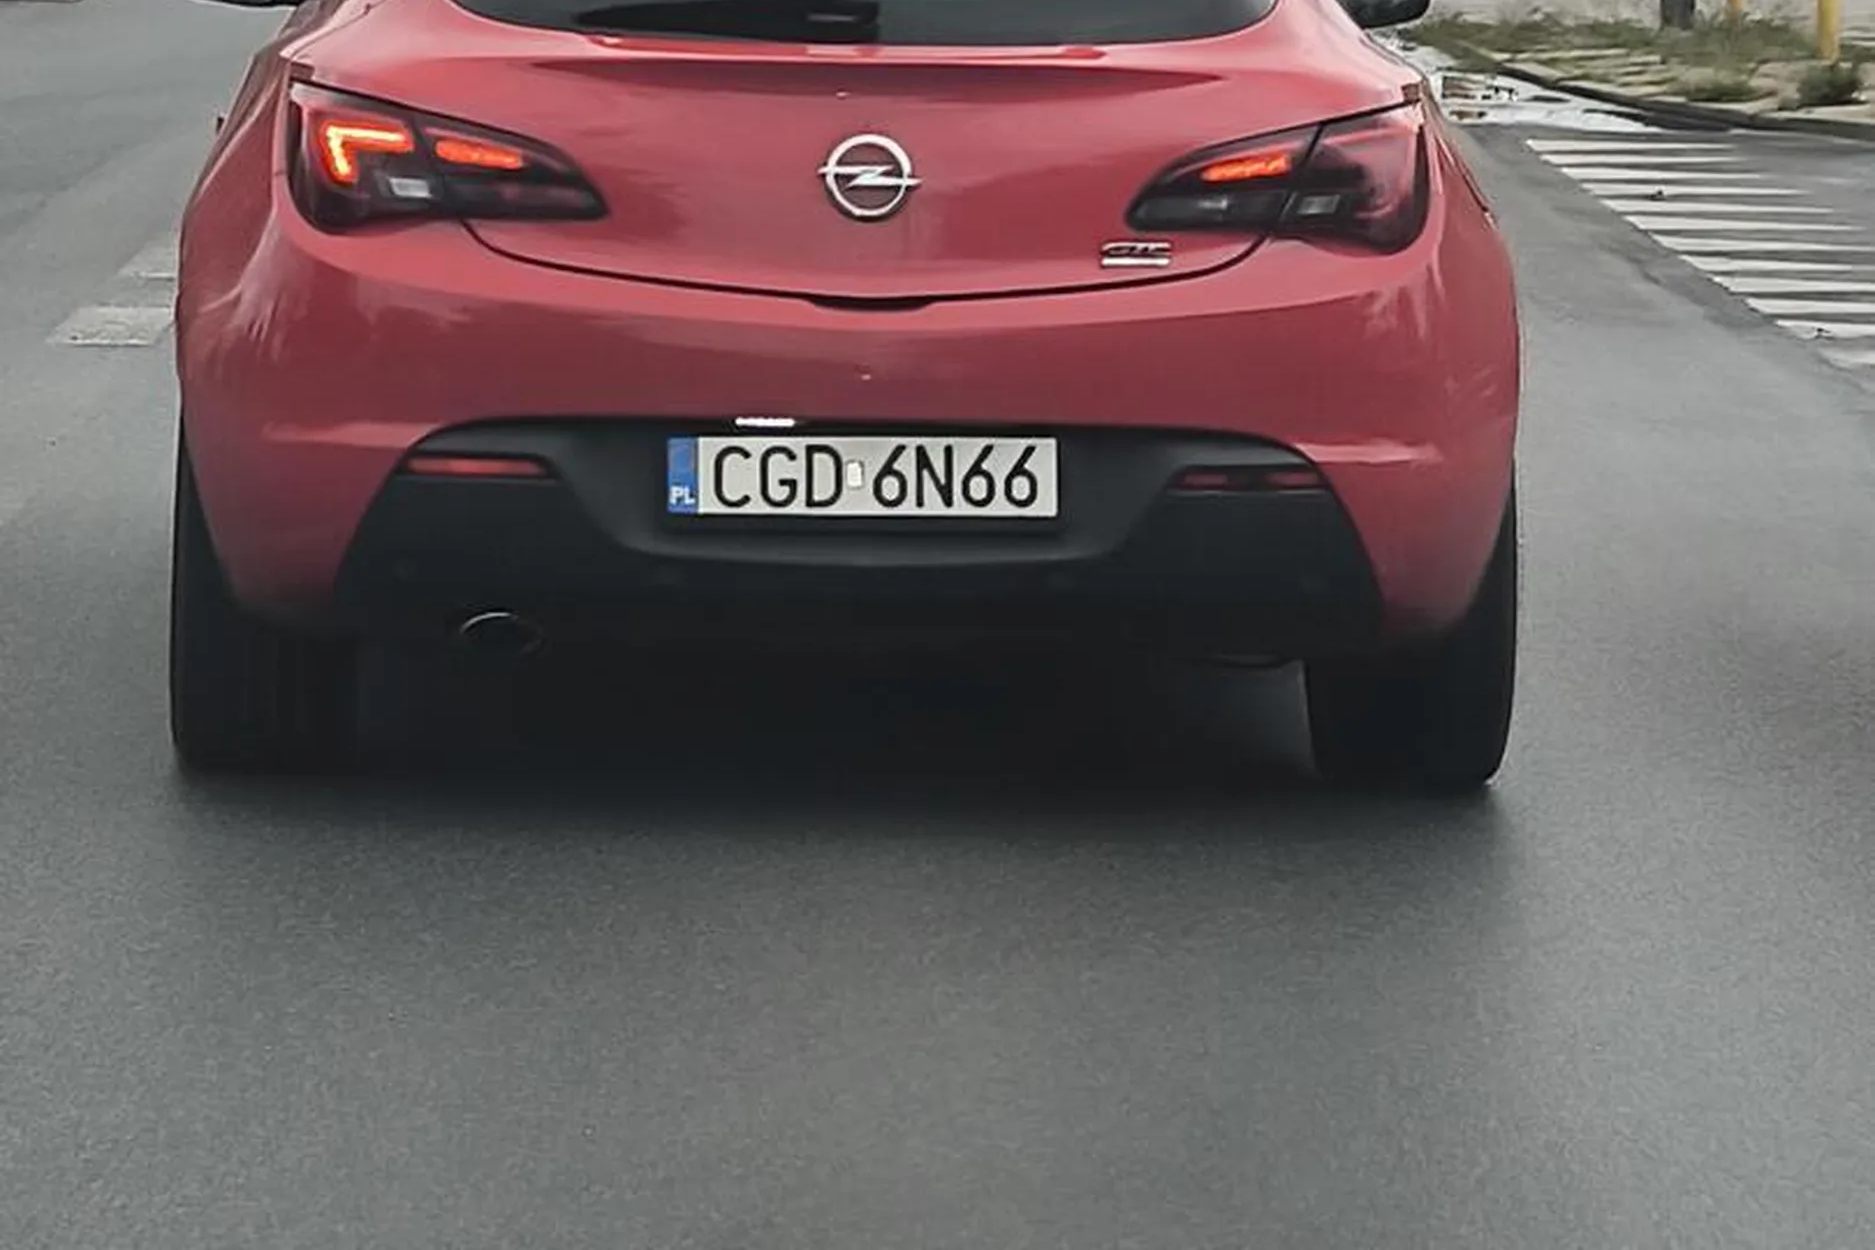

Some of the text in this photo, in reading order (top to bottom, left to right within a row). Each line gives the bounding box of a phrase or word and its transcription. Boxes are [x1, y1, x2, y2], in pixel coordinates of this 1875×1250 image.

[670, 485, 696, 505] PL
[714, 444, 1038, 507] CGD 6N66
